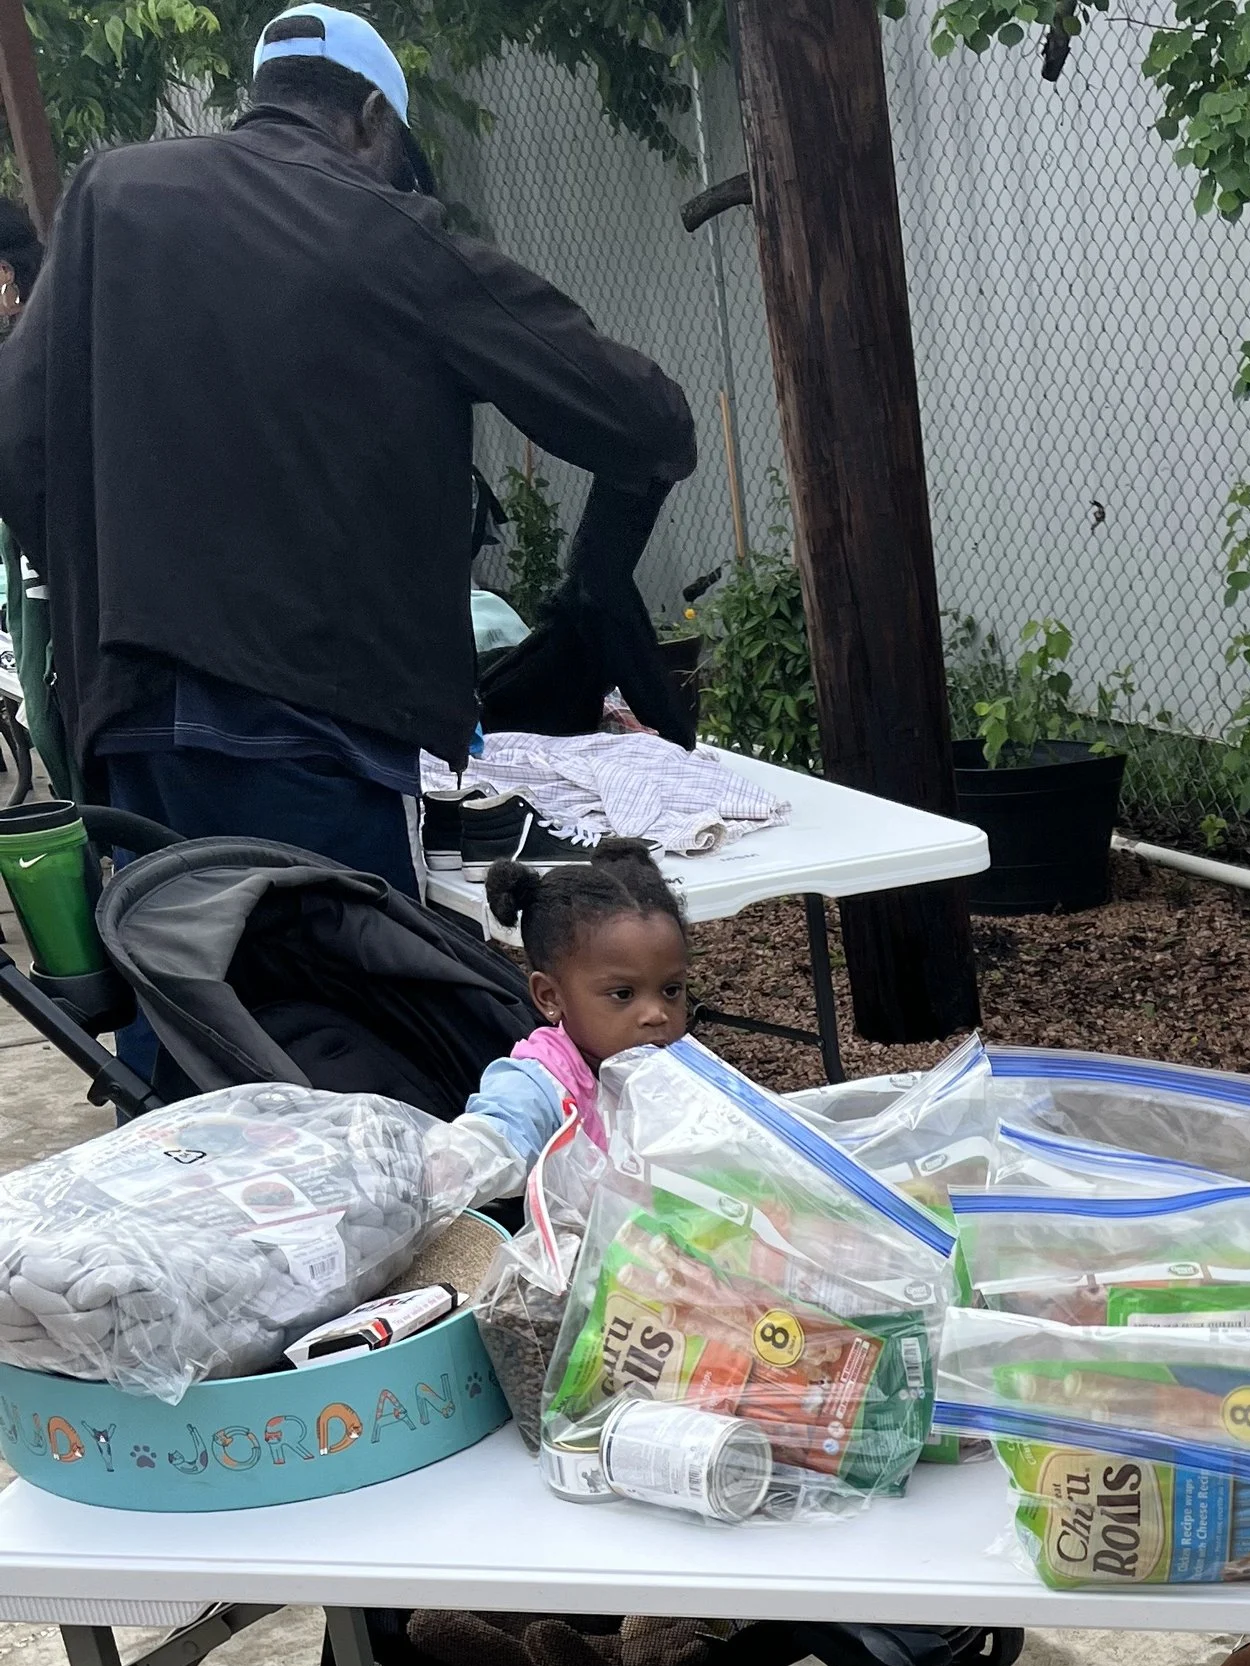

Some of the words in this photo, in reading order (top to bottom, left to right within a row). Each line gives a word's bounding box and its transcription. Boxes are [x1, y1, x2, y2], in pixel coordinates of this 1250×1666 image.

[759, 1323, 789, 1350] 8
[168, 1373, 455, 1476] JORDAN
[1093, 1463, 1142, 1578] Rolls
